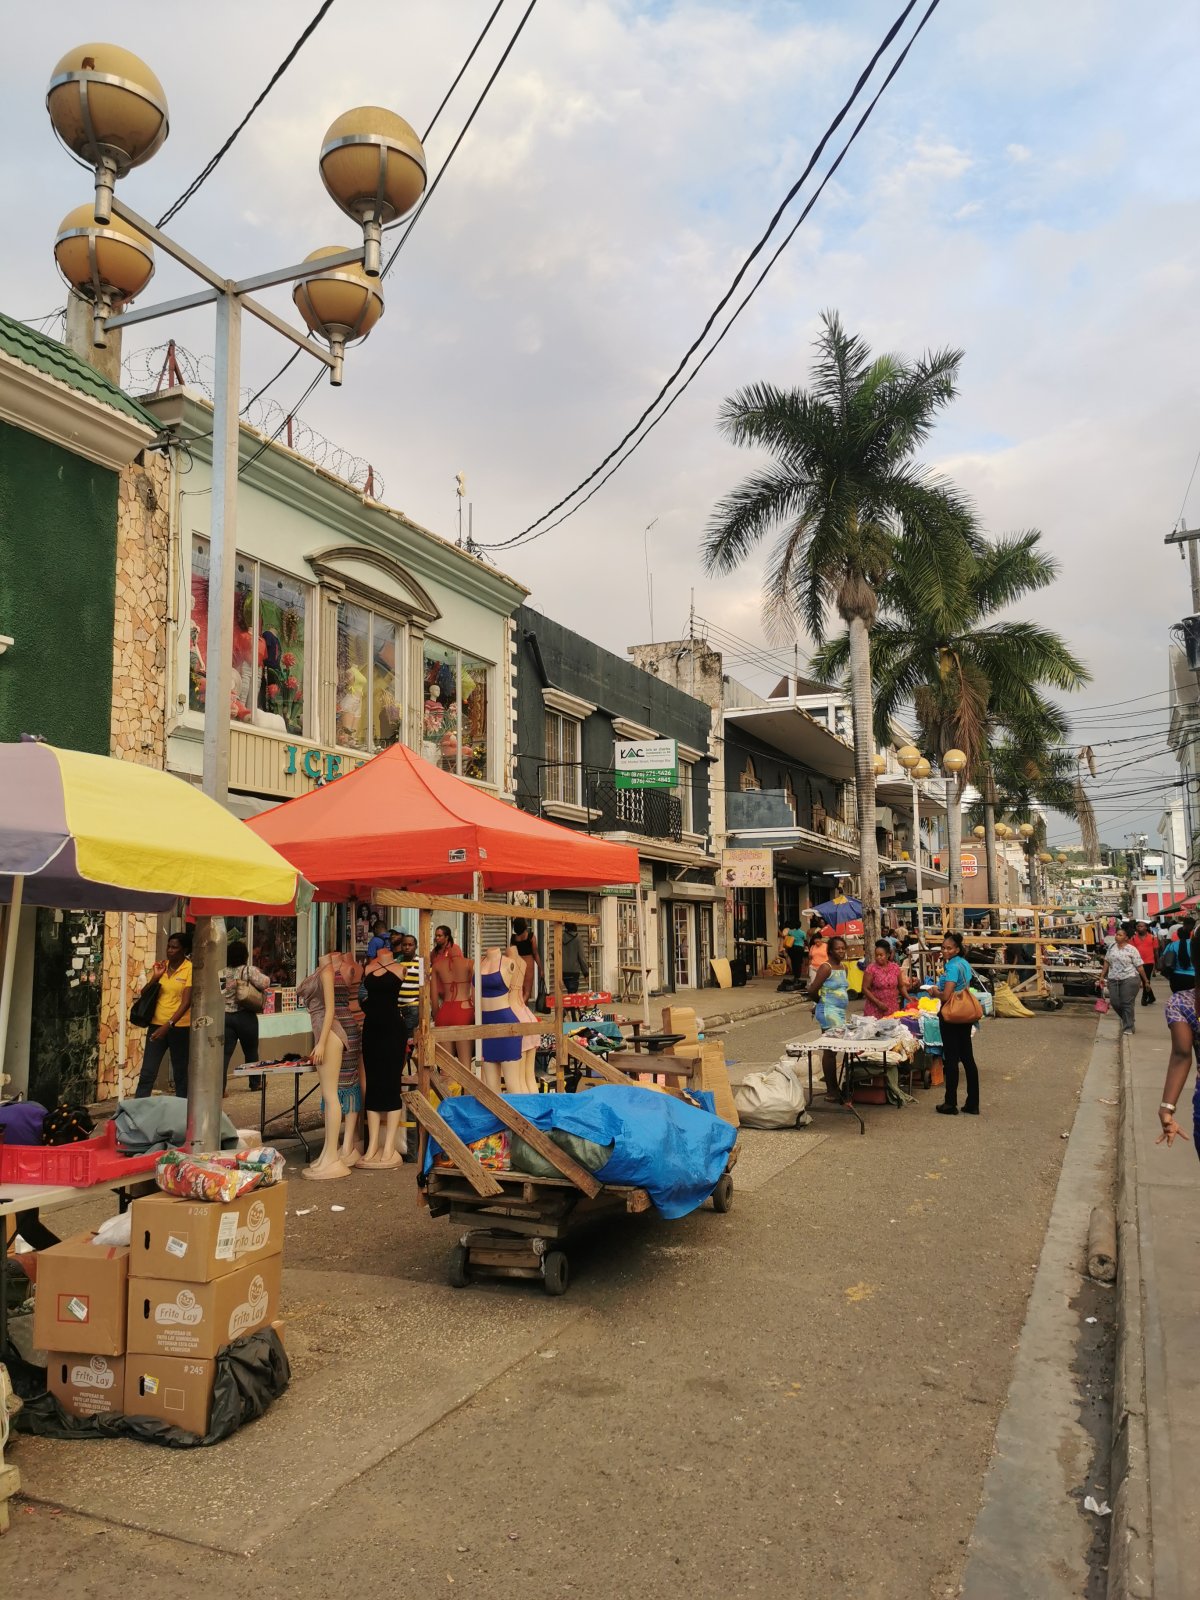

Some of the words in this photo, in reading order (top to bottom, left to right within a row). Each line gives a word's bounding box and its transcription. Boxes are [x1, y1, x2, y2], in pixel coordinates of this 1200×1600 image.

[284, 745, 343, 780] ICE
[233, 1234, 249, 1249] rito
[251, 1230, 266, 1247] Lay
[160, 1308, 180, 1320] Frito
[182, 1311, 198, 1323] Lay
[233, 1311, 250, 1330] Frito
[251, 1305, 265, 1321] Lay
[75, 1370, 94, 1382] Frito
[96, 1375, 110, 1387] Lay
